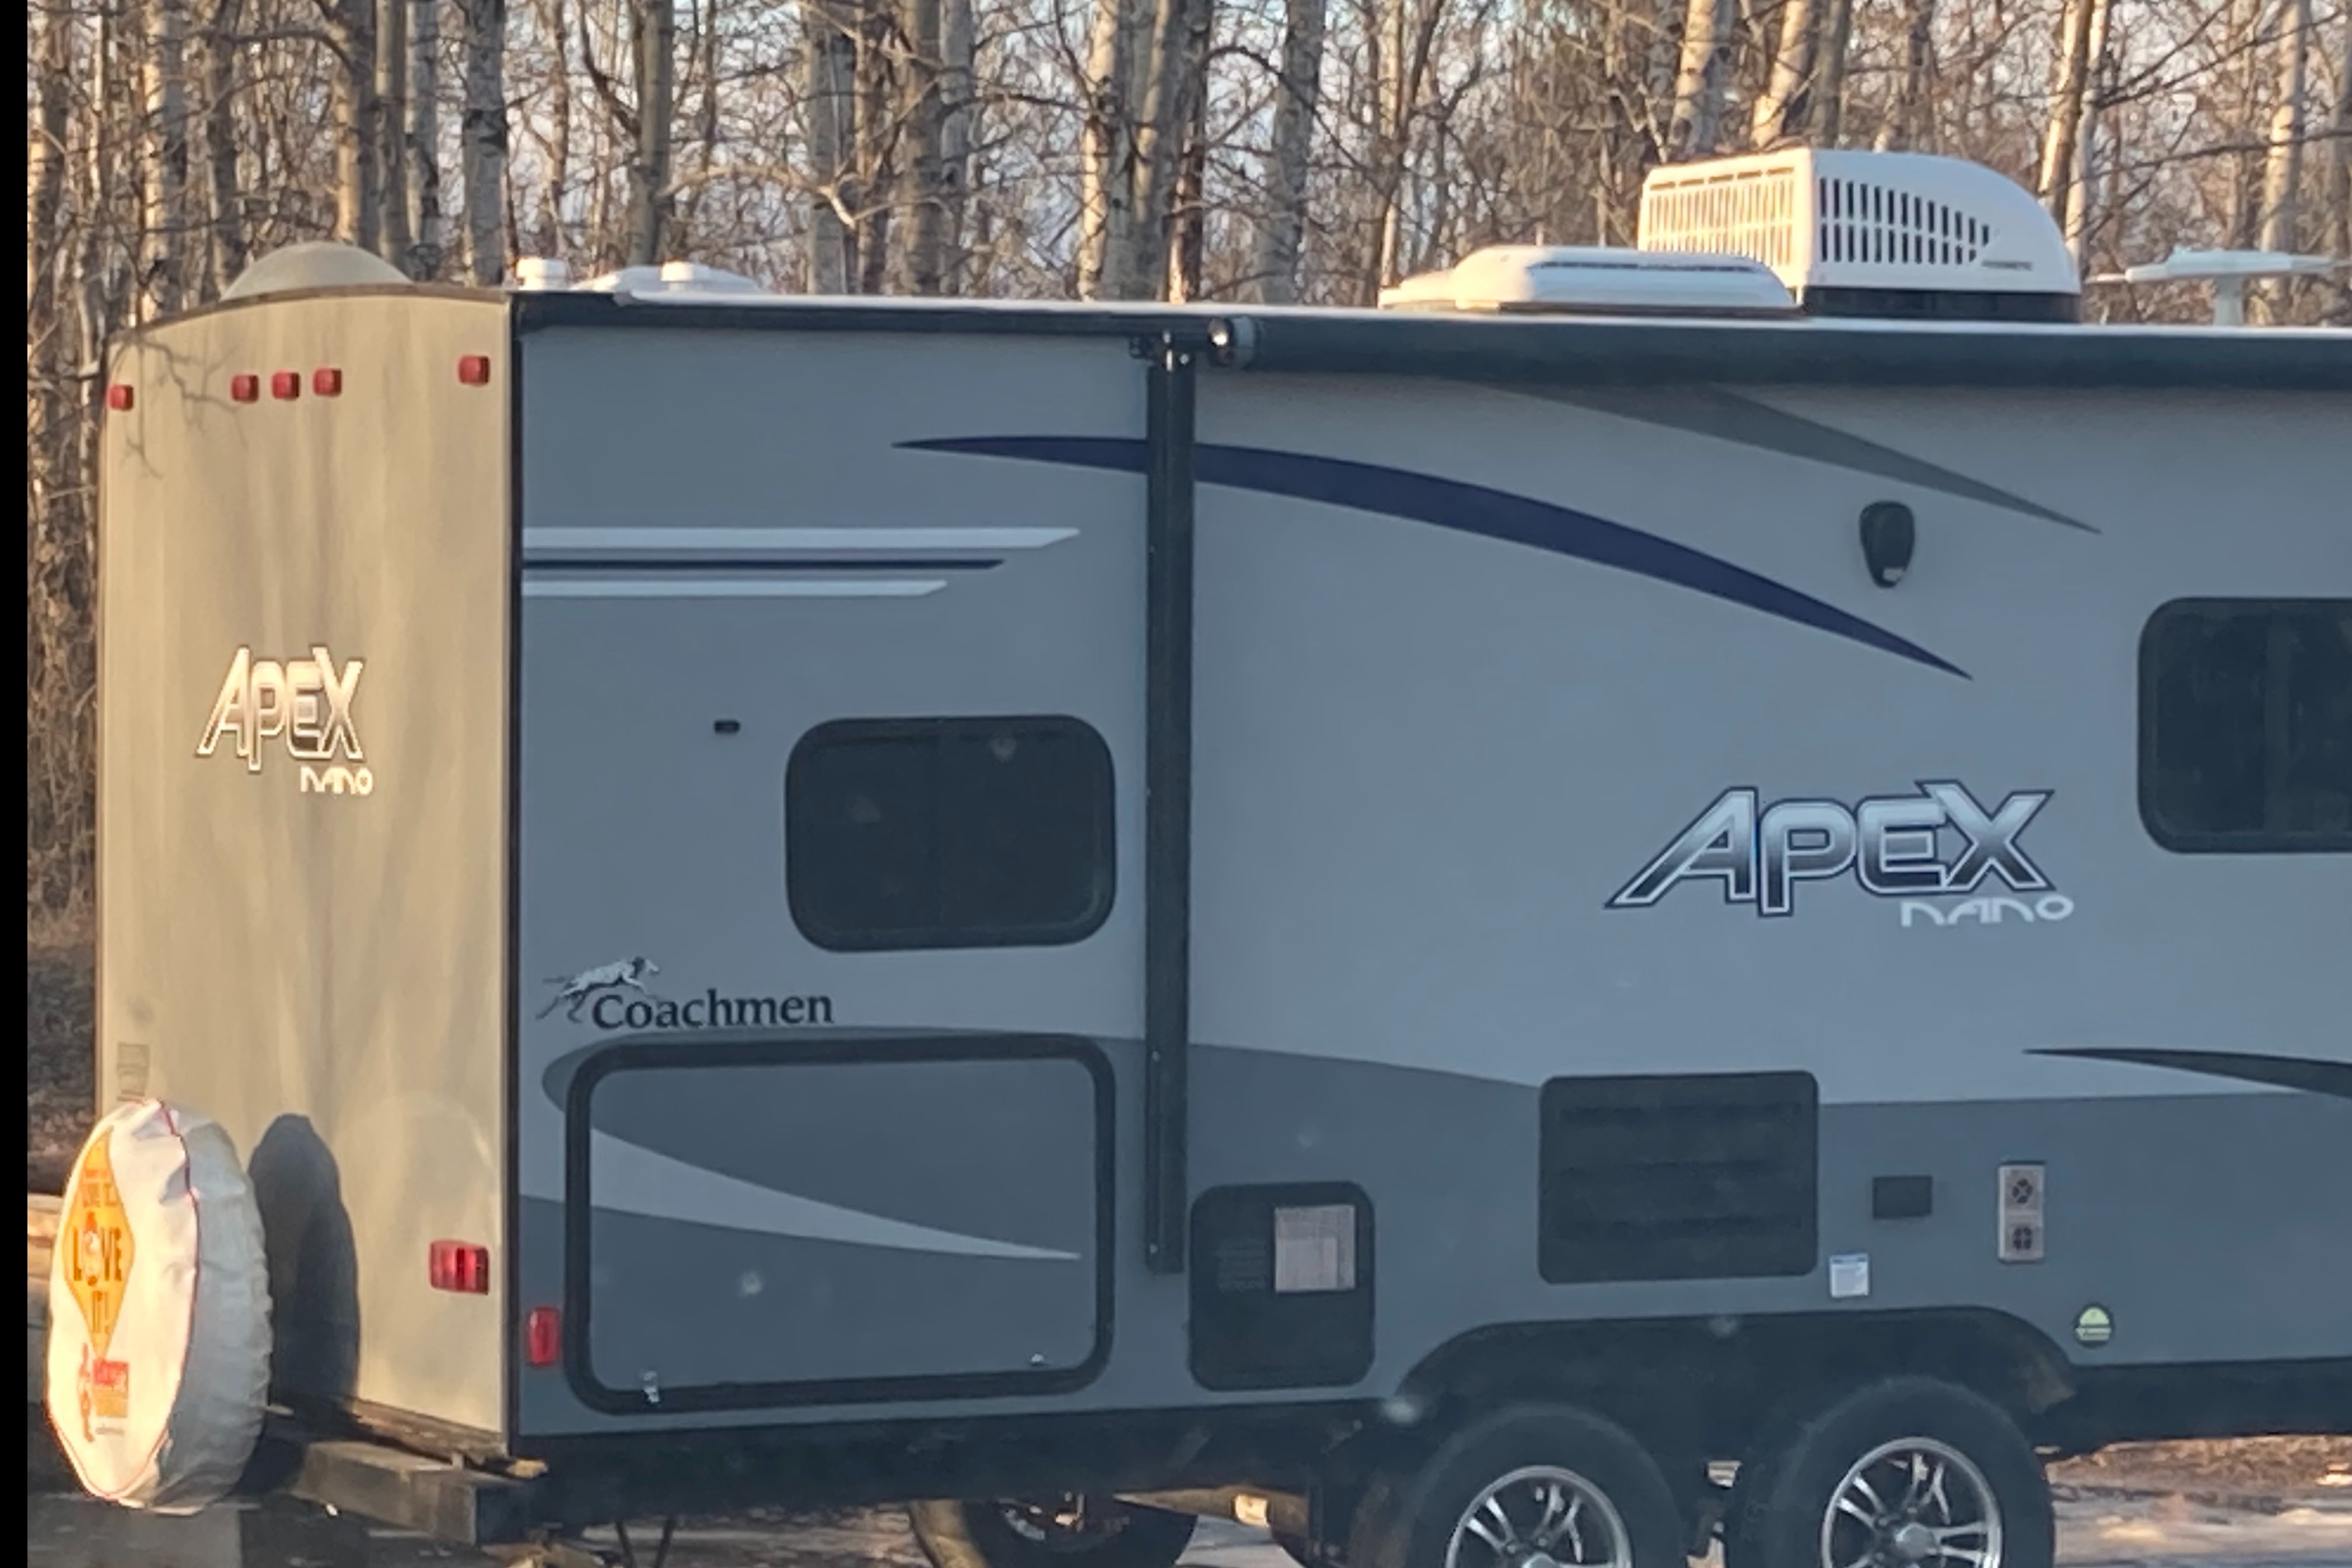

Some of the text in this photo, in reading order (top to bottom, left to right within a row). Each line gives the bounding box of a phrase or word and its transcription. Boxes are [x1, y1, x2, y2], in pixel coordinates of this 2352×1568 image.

[197, 644, 366, 774] APEX
[1603, 779, 2056, 918] APEX
[592, 988, 834, 1030] Coachmen
